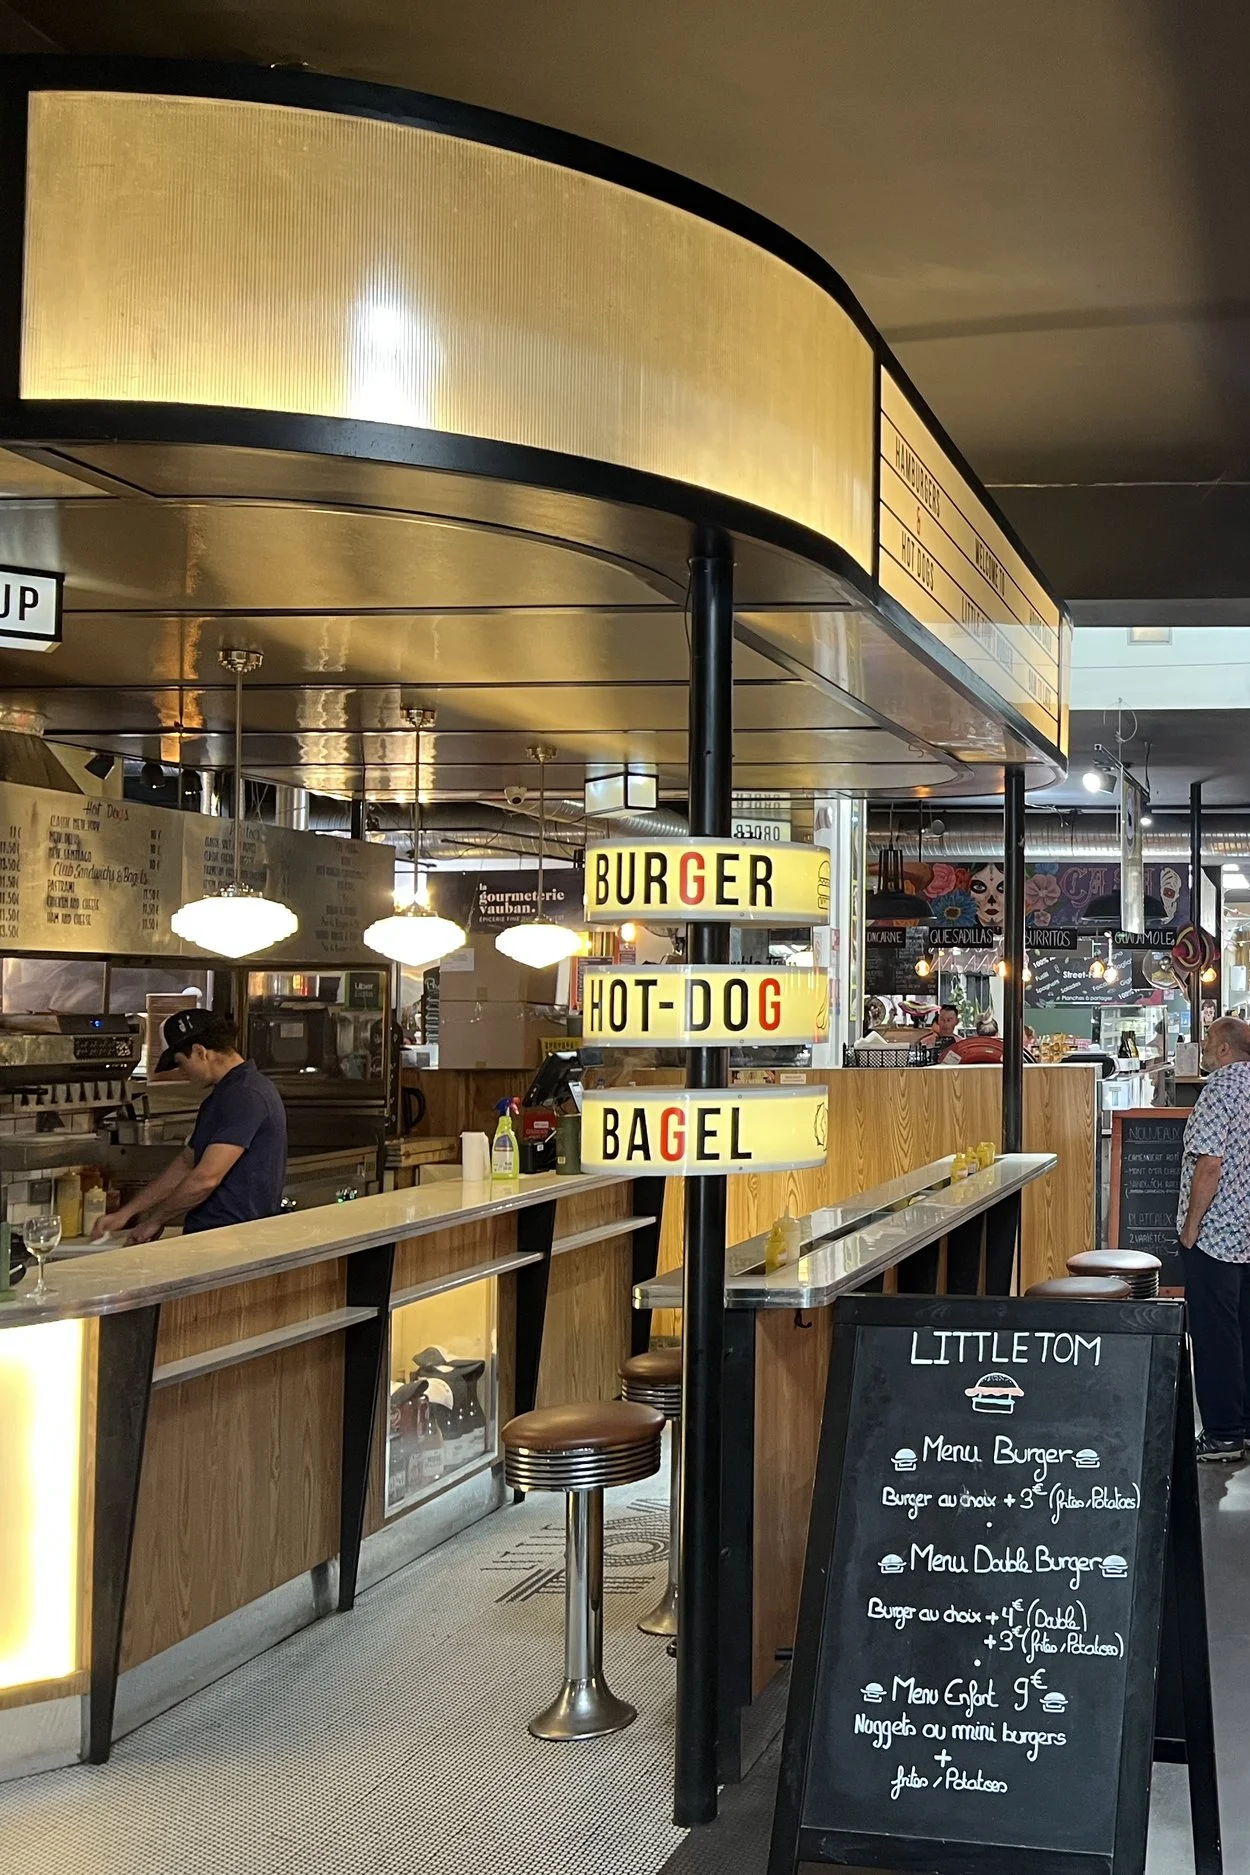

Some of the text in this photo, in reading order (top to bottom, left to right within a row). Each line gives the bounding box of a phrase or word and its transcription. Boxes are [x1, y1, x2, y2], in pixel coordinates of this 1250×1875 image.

[895, 435, 941, 519] HAMBURGERS
[901, 530, 934, 592] HOT DOGS
[975, 537, 1005, 598] WELCOME TO
[479, 888, 565, 906] gourmeterie
[594, 850, 773, 908] BURGER
[479, 902, 536, 915] vauban.
[930, 928, 993, 945] QUESADILLAS
[590, 977, 782, 1033] HOT-DOG
[602, 1106, 753, 1163] BAGEL
[910, 1330, 1102, 1367] LITTLE TOM
[922, 1434, 1074, 1483] Menu Burger
[882, 1486, 933, 1520] Burger
[937, 1493, 957, 1509] au
[959, 1486, 997, 1510] choix
[1003, 1493, 1017, 1509] +
[1019, 1482, 1048, 1510] 3€
[909, 1543, 1104, 1591] Menu Double Burger
[867, 1597, 1087, 1632] Burger au choix + 4€ (Double)
[983, 1634, 997, 1650] +
[891, 1668, 1048, 1719] Menu Enfant 9€
[854, 1713, 1067, 1762] Nuggets ou mini burgers
[933, 1748, 953, 1769] +
